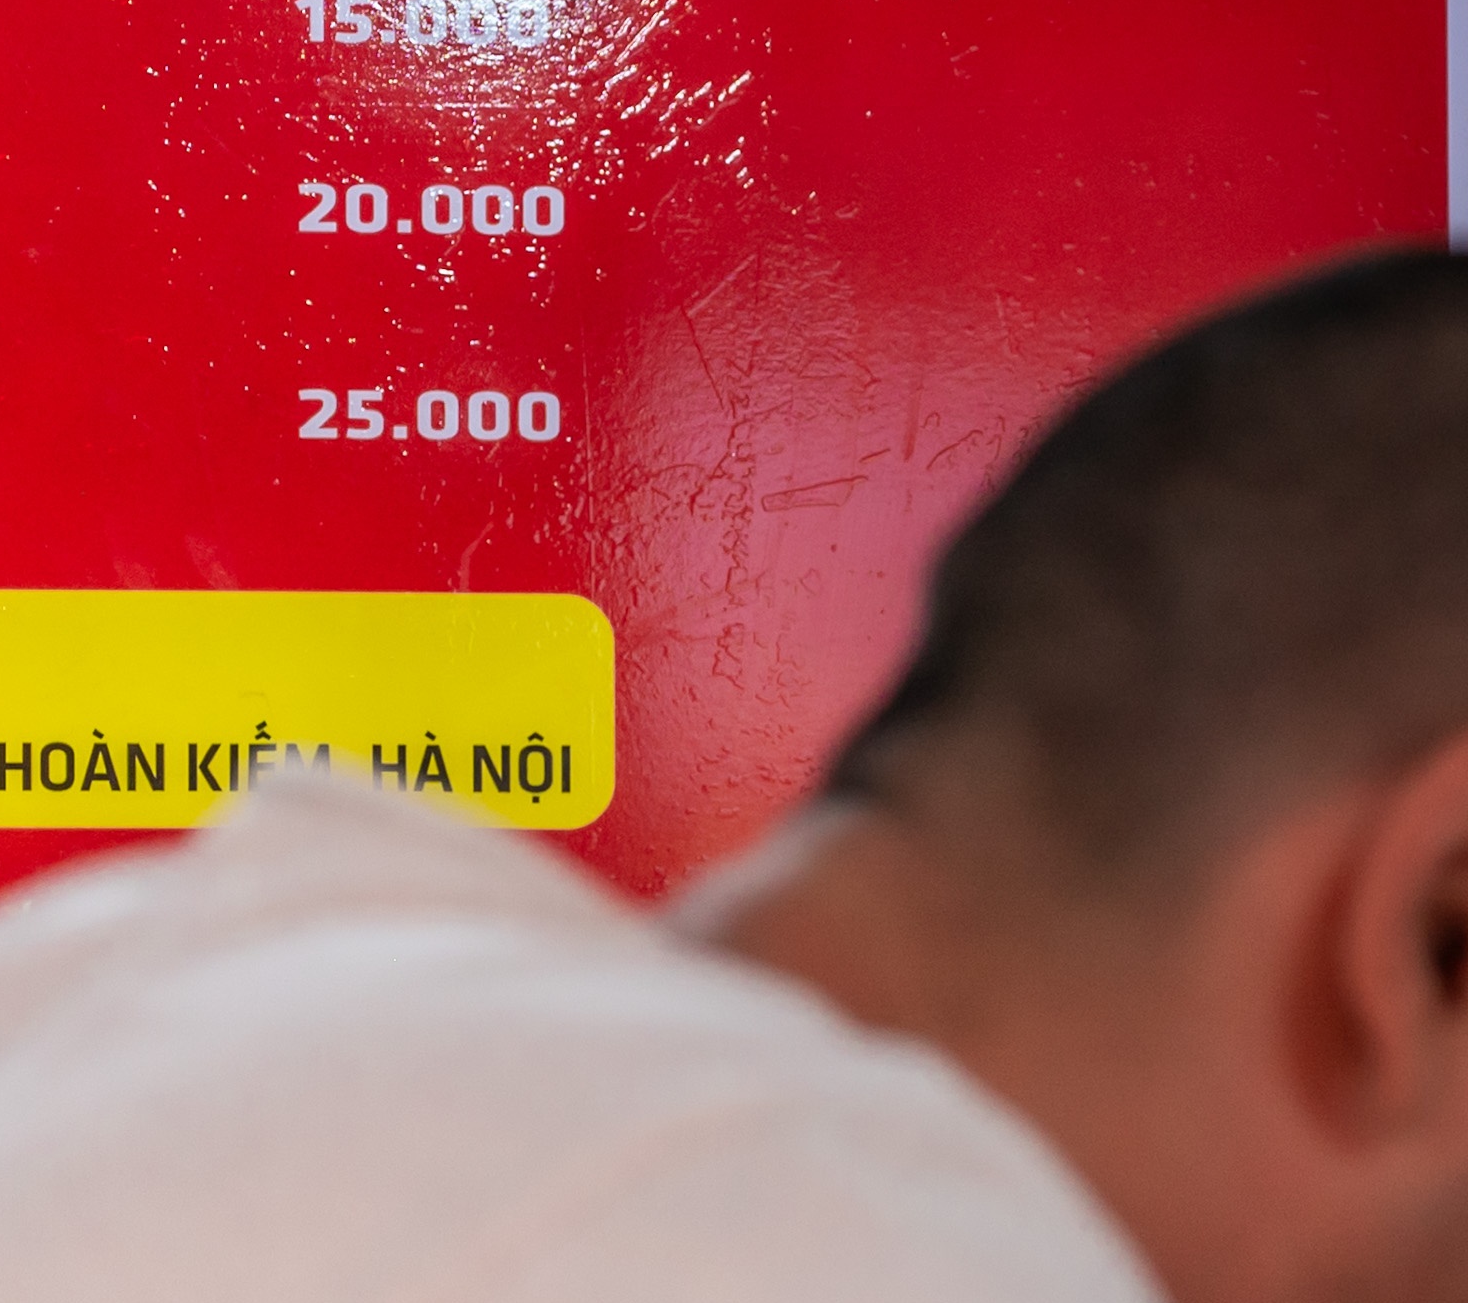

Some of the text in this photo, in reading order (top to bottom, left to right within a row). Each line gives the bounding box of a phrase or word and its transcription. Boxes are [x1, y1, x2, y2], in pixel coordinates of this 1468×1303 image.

[298, 183, 564, 236] 20.000
[299, 386, 560, 441] 25.000
[373, 732, 452, 791] HÀ
[473, 732, 571, 804] NỘI
